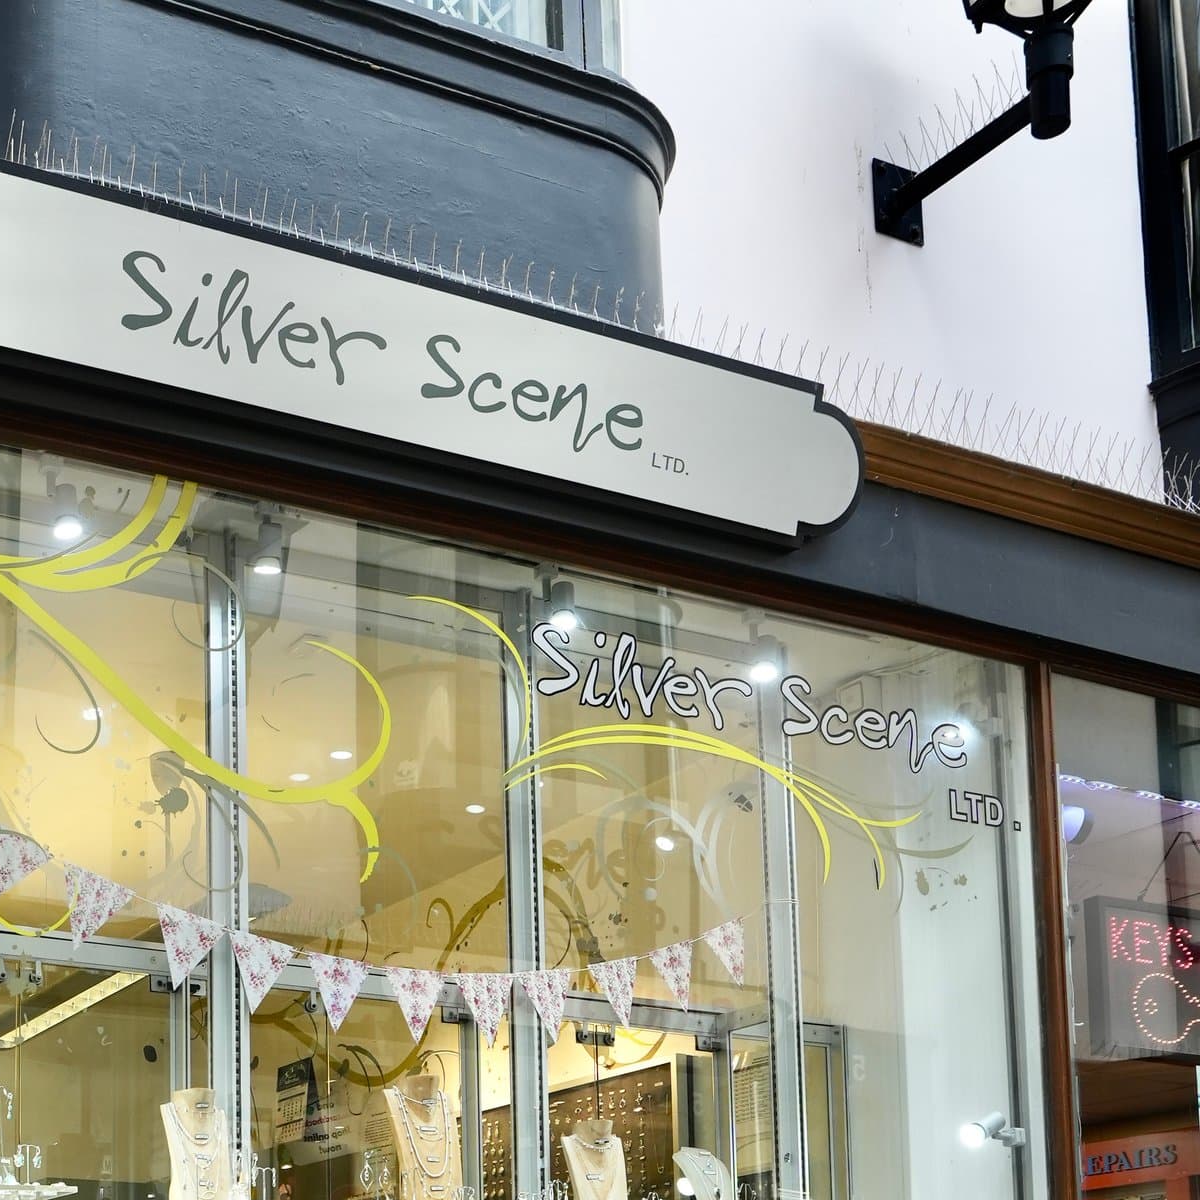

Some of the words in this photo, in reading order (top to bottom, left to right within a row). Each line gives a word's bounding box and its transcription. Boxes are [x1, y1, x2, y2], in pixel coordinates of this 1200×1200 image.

[121, 250, 387, 386] Silver
[421, 334, 644, 452] Scene
[651, 452, 689, 476] LTD.
[532, 622, 753, 730] Silver
[781, 675, 968, 774] Scene
[1110, 916, 1194, 969] KEYS
[1087, 1144, 1178, 1176] EPAIRS
